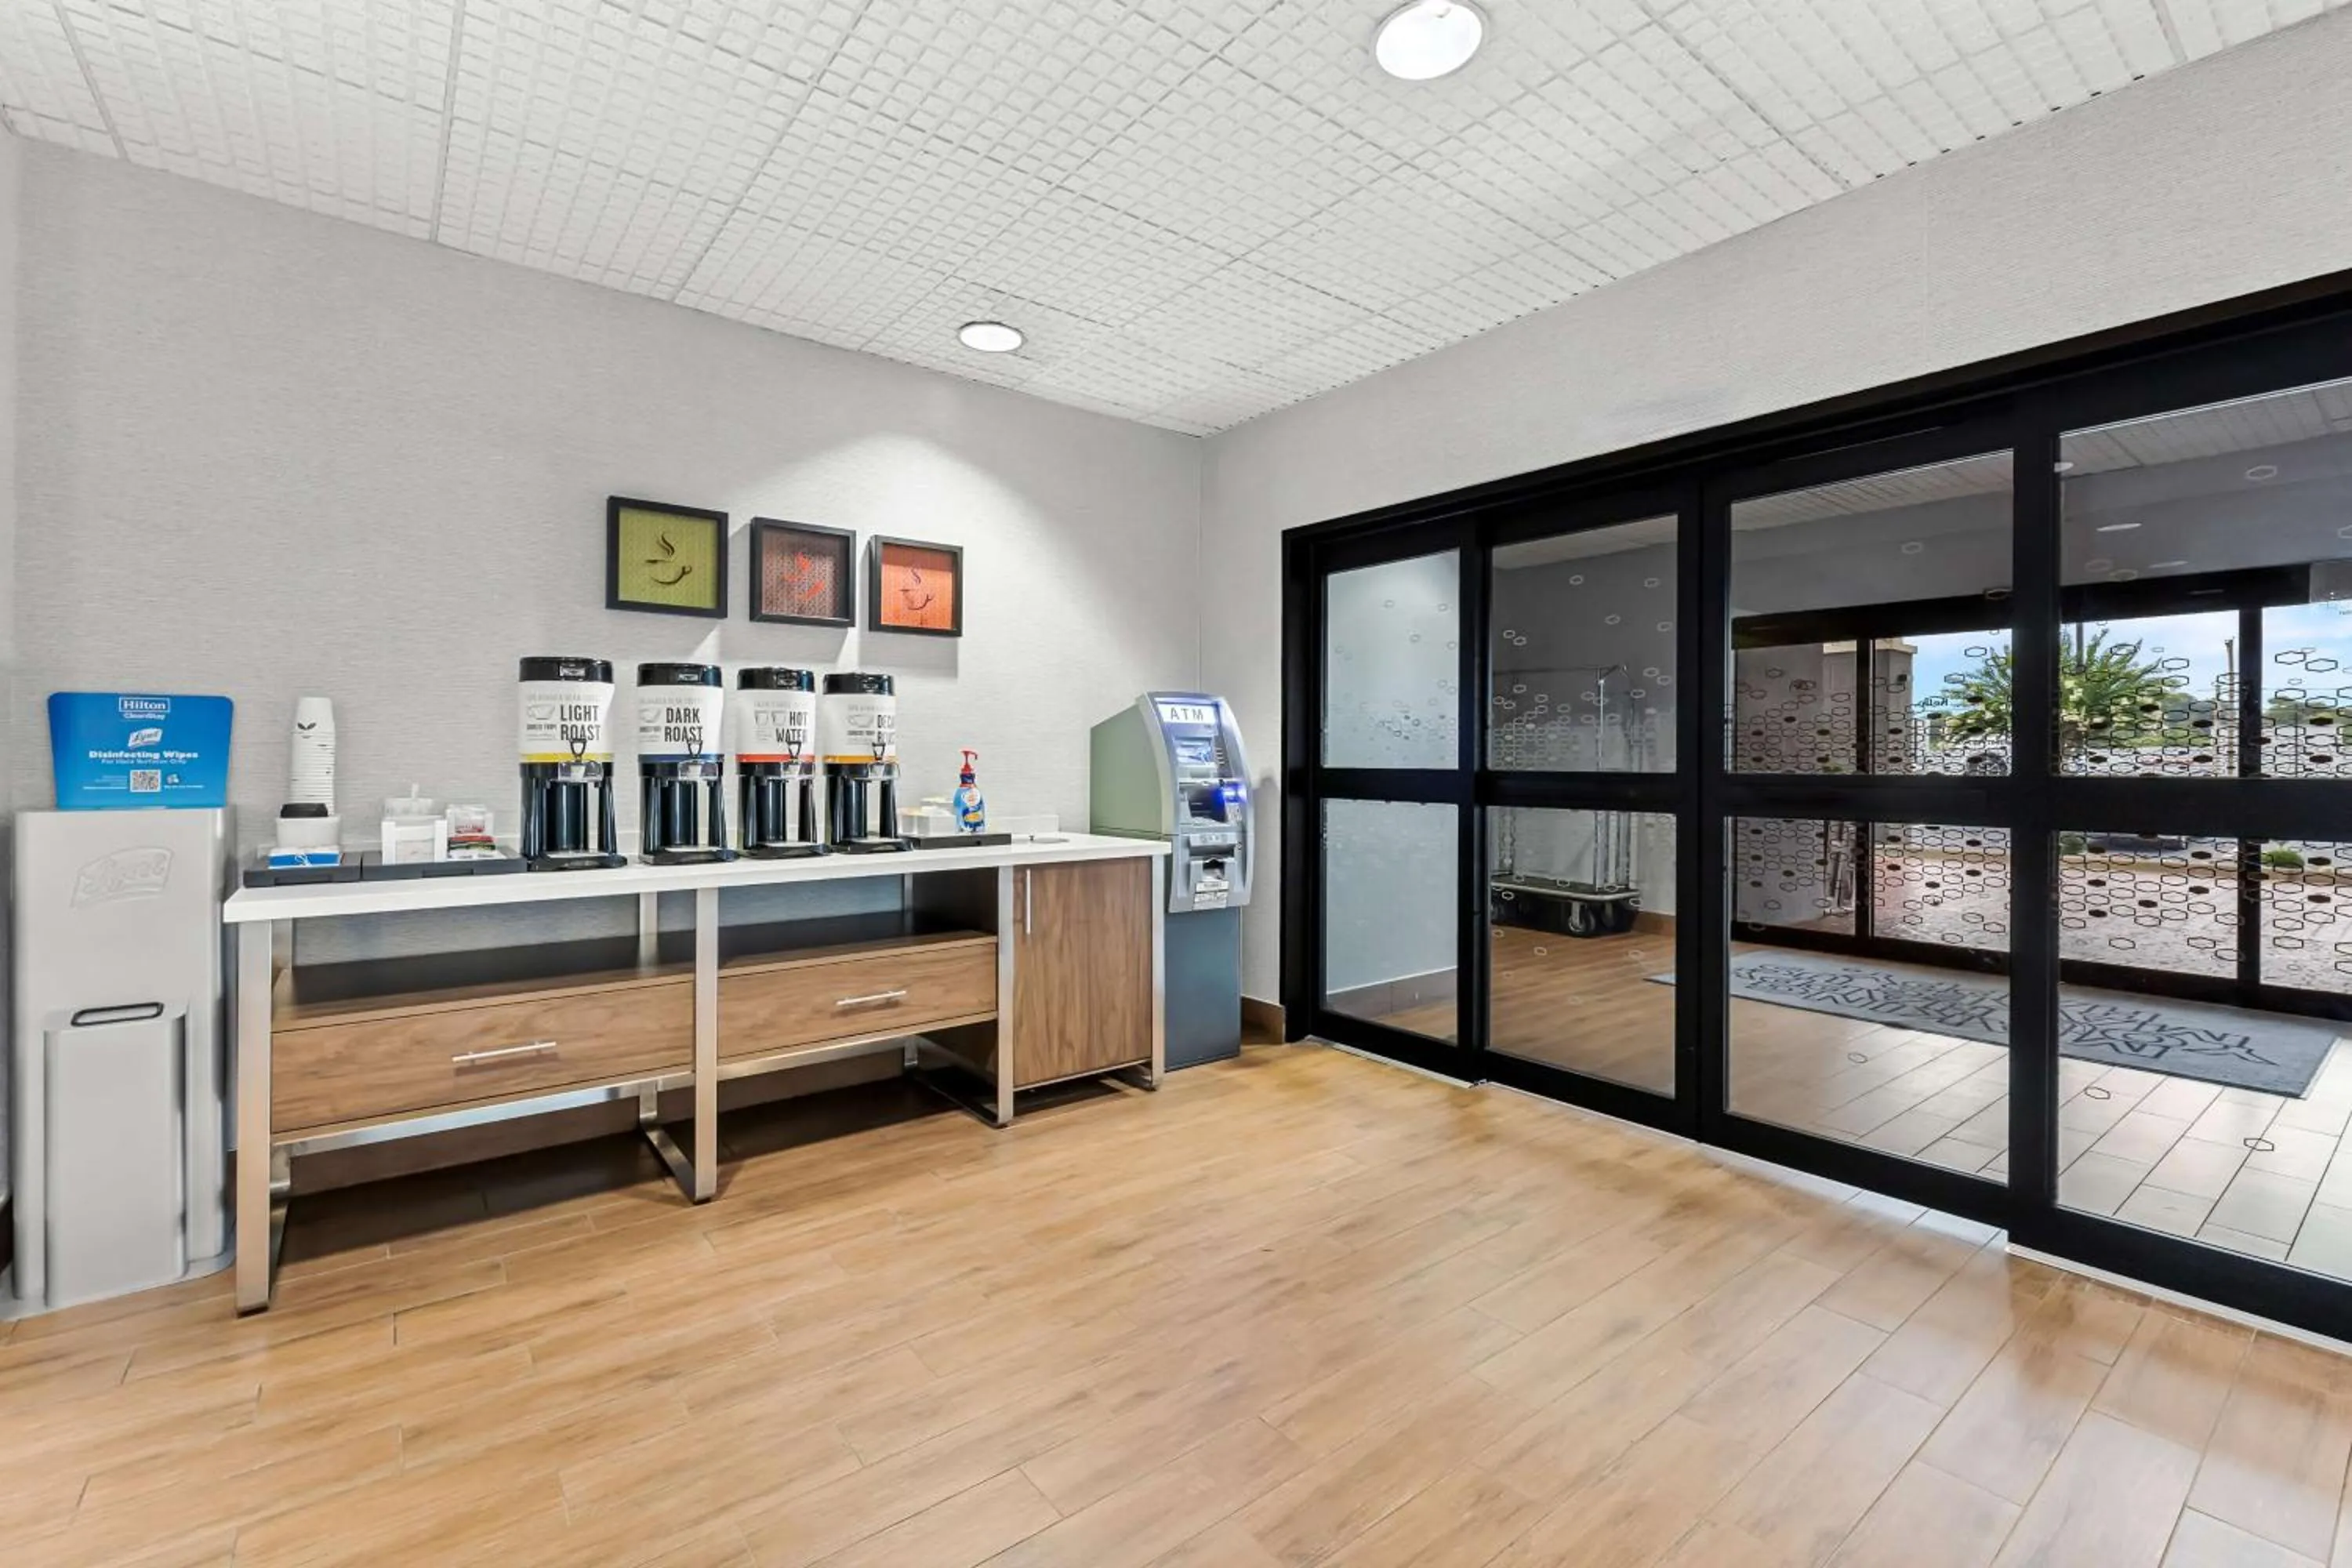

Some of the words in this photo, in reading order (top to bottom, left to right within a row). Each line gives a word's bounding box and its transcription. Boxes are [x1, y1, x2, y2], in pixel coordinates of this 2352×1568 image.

[123, 700, 166, 710] Hilton
[560, 704, 599, 722] LIGHT
[666, 707, 700, 724] DARK
[789, 711, 808, 727] HOT
[1171, 707, 1204, 721] ATM
[560, 724, 601, 741] ROAST
[664, 726, 703, 742] ROAST
[89, 750, 160, 759] Disinfecting
[162, 750, 198, 760] Wipes
